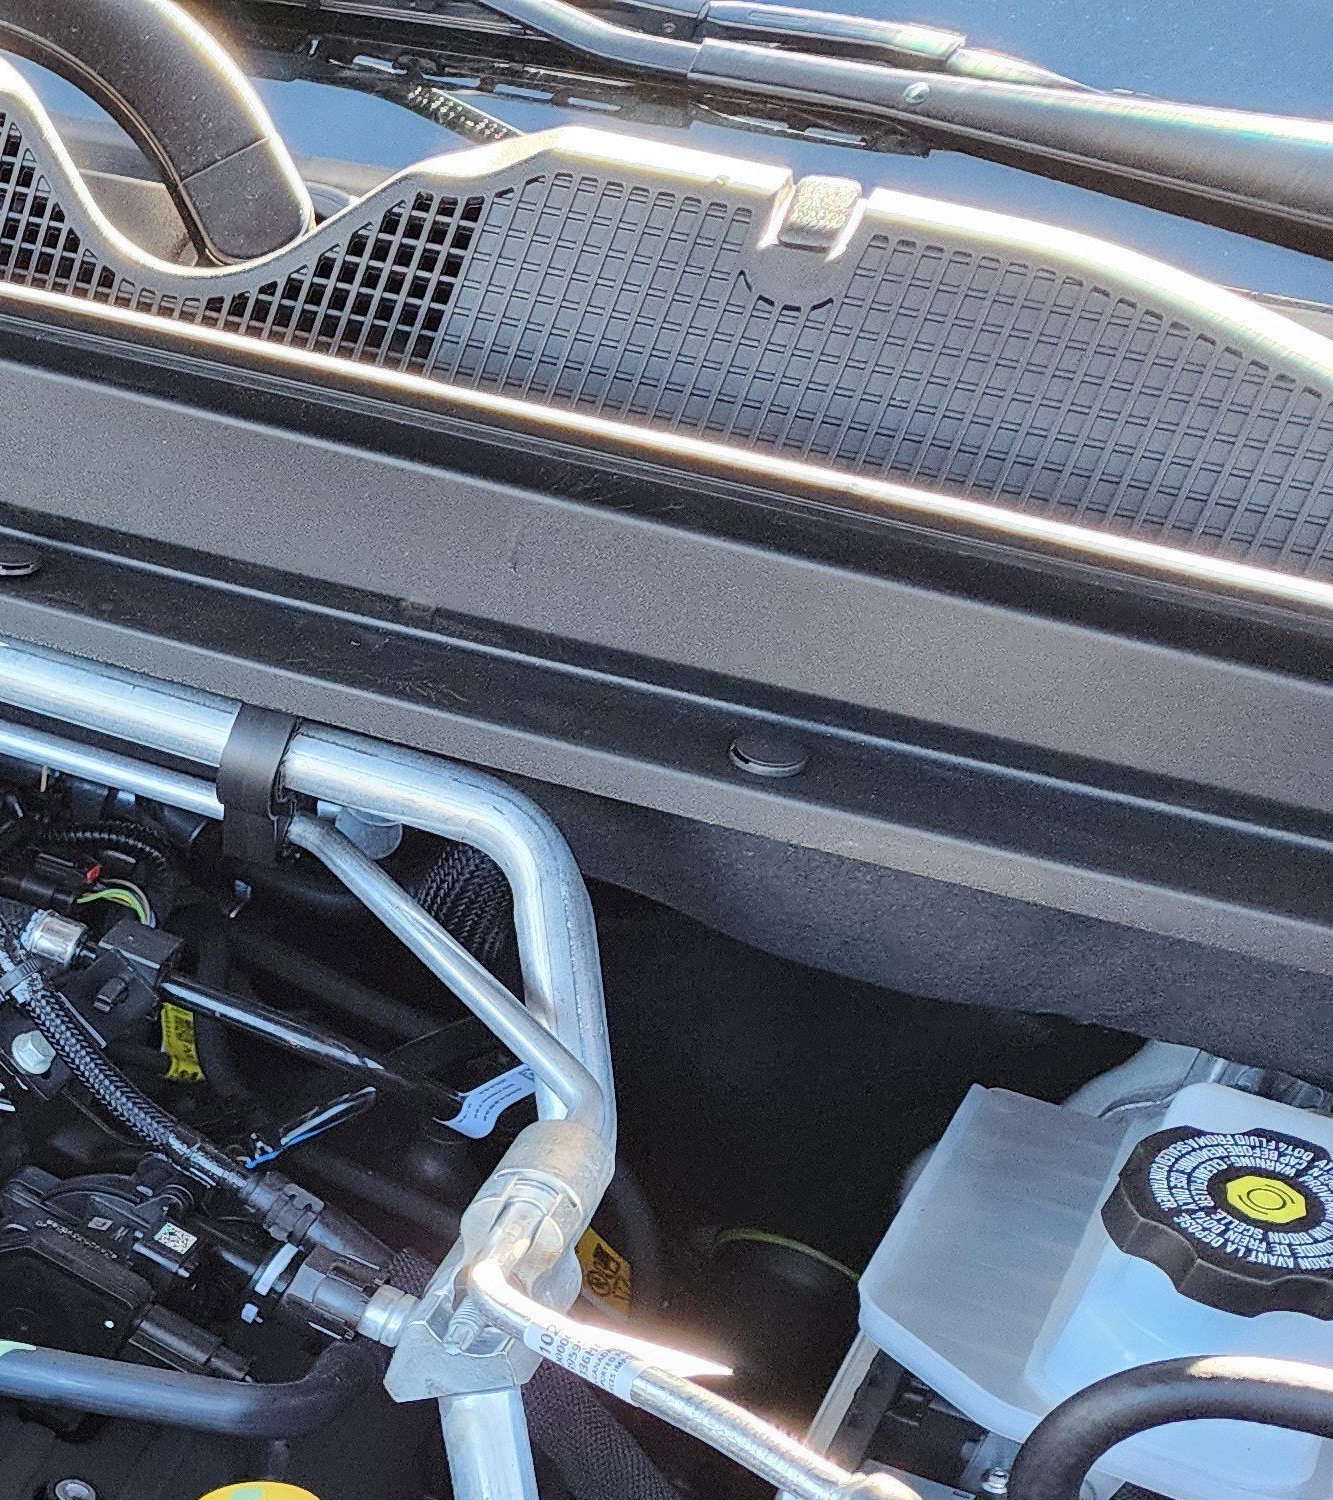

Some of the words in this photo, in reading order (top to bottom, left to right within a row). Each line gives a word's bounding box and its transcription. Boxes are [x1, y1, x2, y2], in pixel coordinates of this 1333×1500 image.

[1222, 1144, 1279, 1160] BEFORE
[1279, 1152, 1308, 1169] CAP
[1225, 1156, 1297, 1177] WARNING:
[1224, 1230, 1267, 1252] FREIN
[1269, 1242, 1292, 1256] DE
[1247, 1250, 1295, 1269] AVANT
